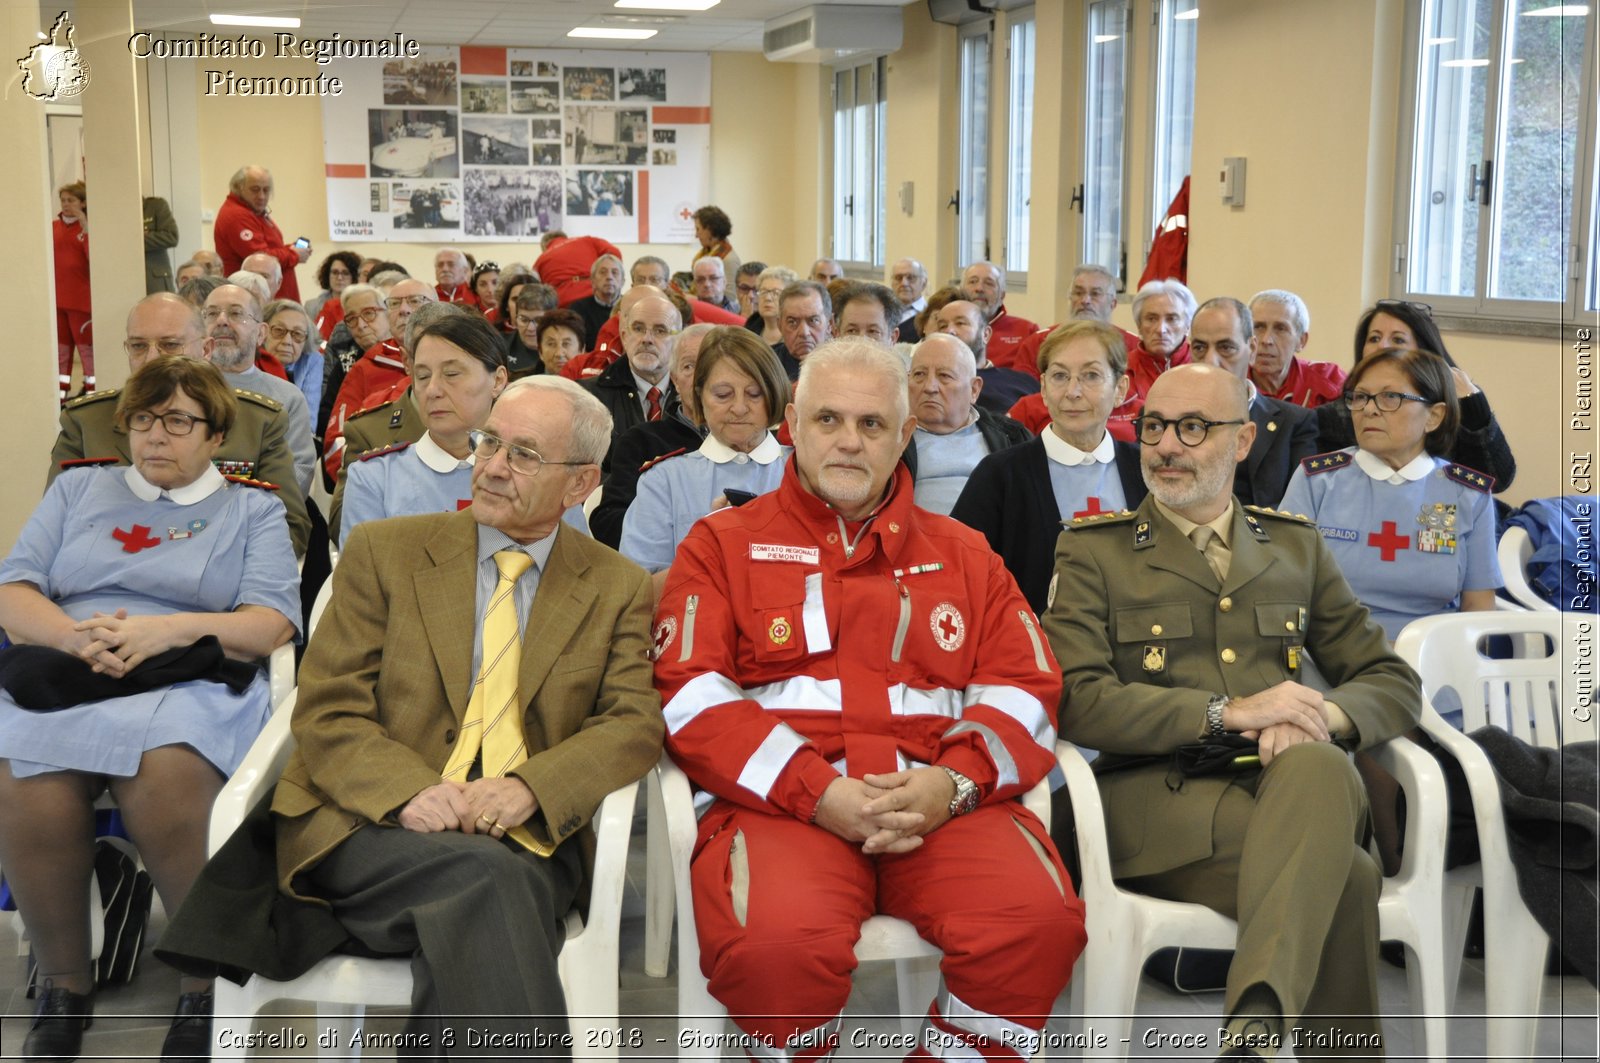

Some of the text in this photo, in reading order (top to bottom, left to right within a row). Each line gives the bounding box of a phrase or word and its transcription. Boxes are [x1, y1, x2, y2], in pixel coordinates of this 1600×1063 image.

[333, 219, 373, 228] Un'Italia
[1320, 528, 1357, 540] GRIBALDO
[785, 547, 817, 556] REGIONALE
